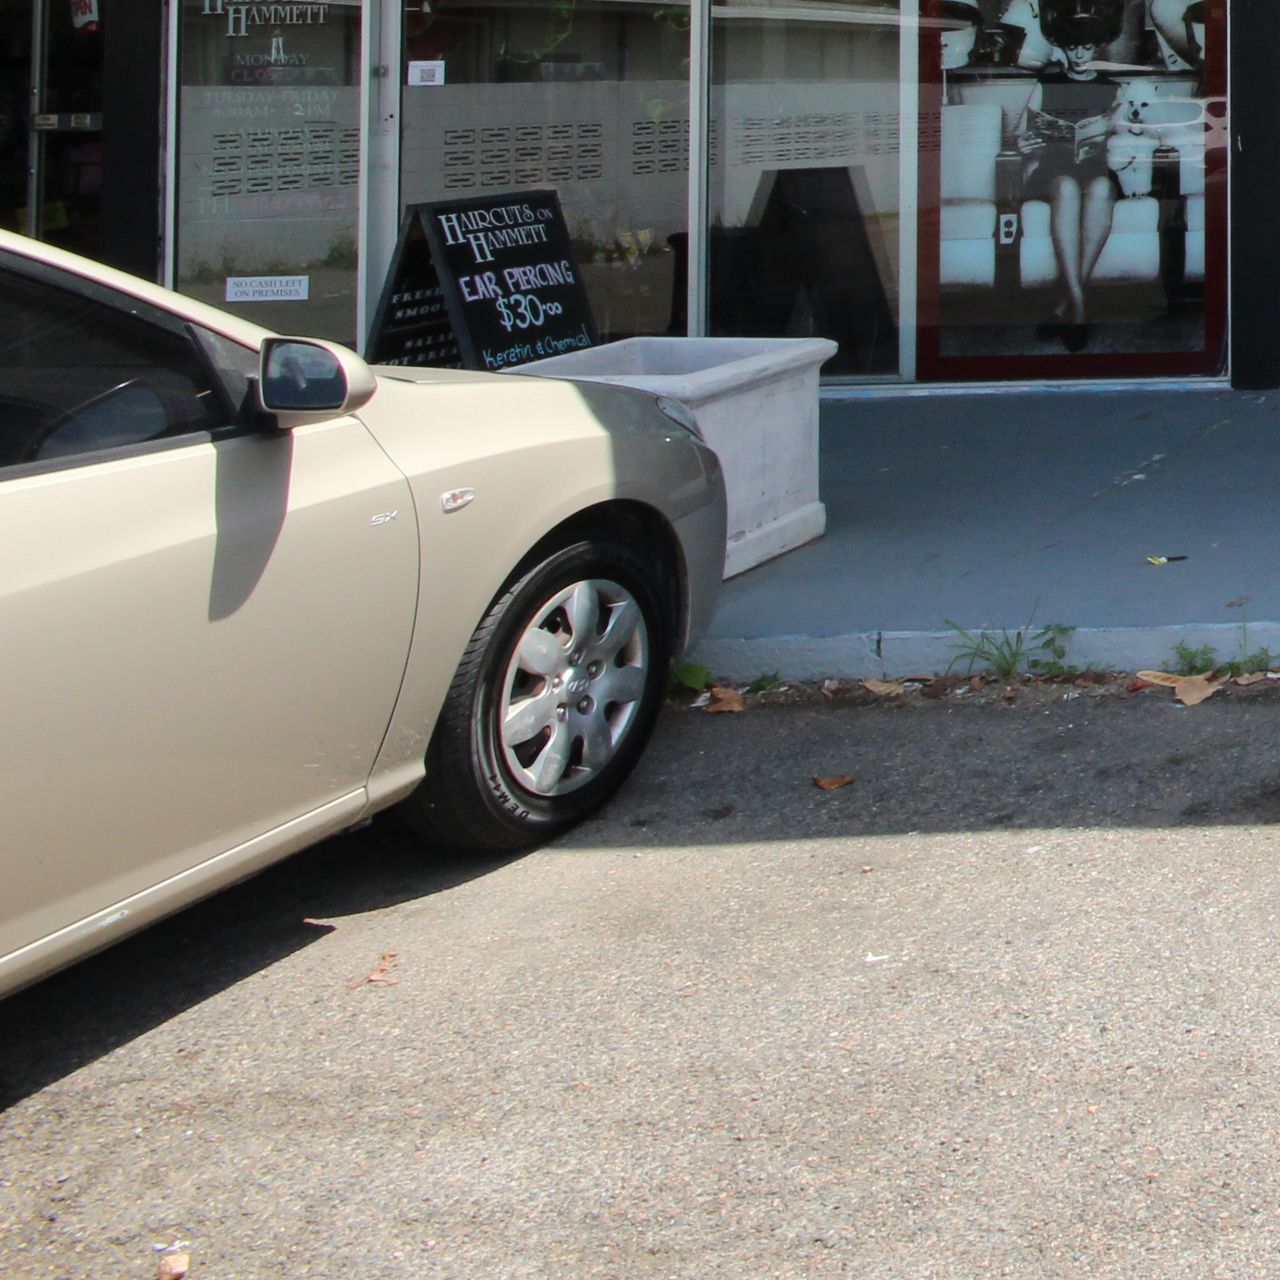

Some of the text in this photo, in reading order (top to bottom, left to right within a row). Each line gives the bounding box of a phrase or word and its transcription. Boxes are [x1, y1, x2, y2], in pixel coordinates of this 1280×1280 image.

[225, 4, 328, 37] HAMMETT
[436, 204, 552, 245] HAIRCUTS ON
[466, 224, 548, 263] HAMMETT
[249, 280, 276, 288] CASH
[251, 289, 300, 297] PREMISES
[459, 260, 575, 302] EAR PIERCING
[483, 344, 533, 368] Keratin
[544, 323, 591, 352] Chemical
[371, 510, 398, 525] SX
